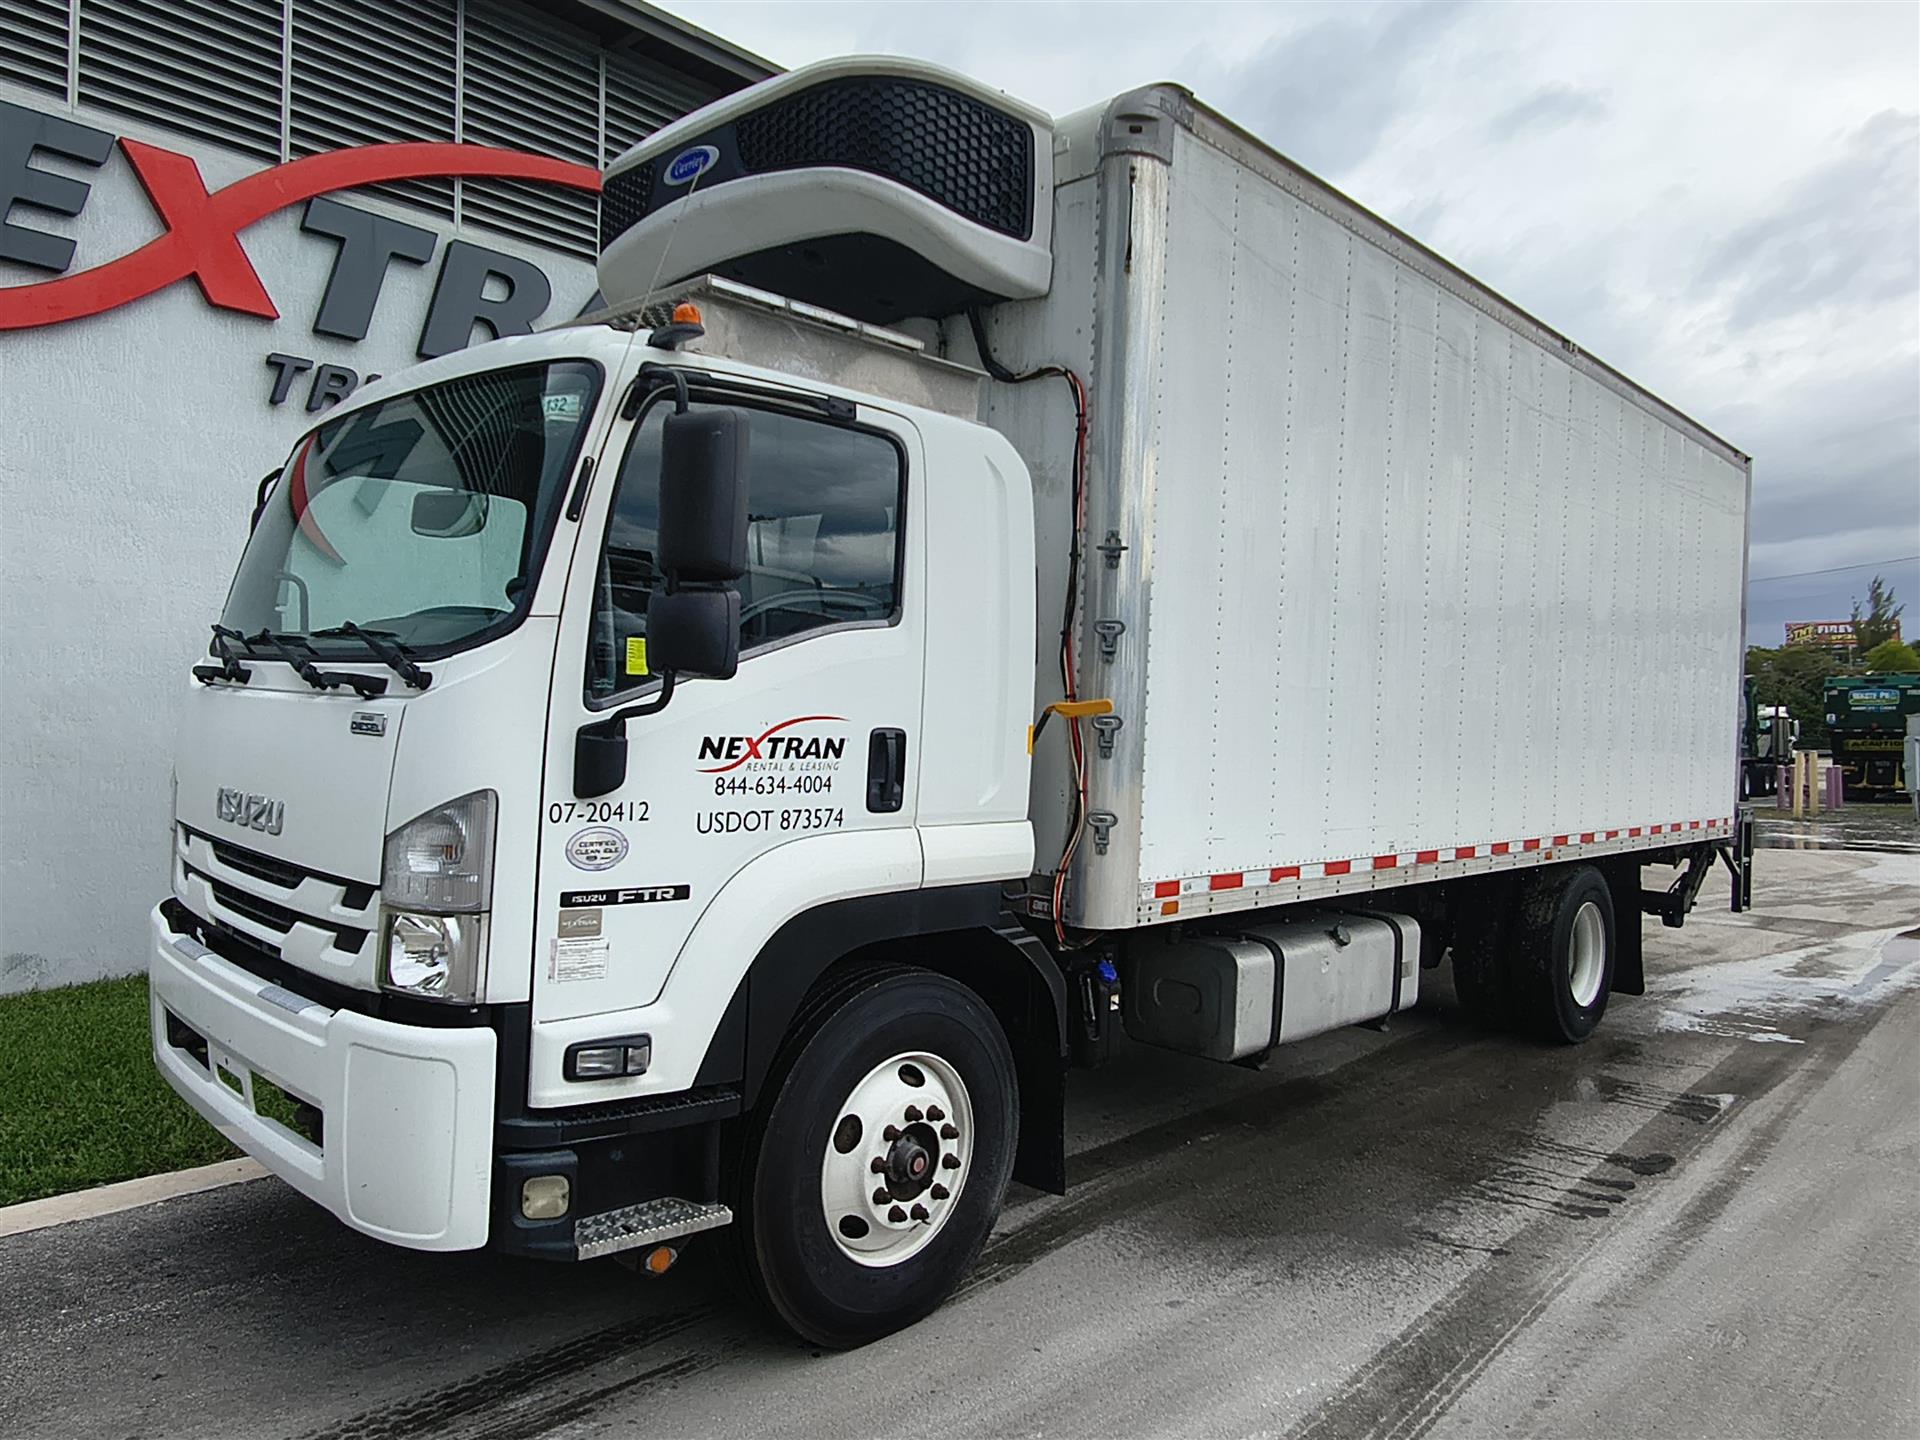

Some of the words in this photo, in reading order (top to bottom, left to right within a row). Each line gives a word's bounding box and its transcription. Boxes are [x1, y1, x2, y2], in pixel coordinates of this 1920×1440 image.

[0, 101, 608, 358] EXTR
[264, 352, 381, 412] TR
[697, 736, 846, 760] NEXTRAN
[745, 761, 784, 772] RENTAL
[788, 762, 796, 771] &
[800, 760, 839, 772] LEASING
[714, 775, 832, 796] 844-634-4004
[216, 787, 285, 836] ISUZU
[548, 800, 650, 825] 07-20412
[696, 810, 775, 835] USDOT
[779, 807, 845, 830] 873574
[571, 893, 607, 904] ISUZU
[617, 887, 675, 903] FTR
